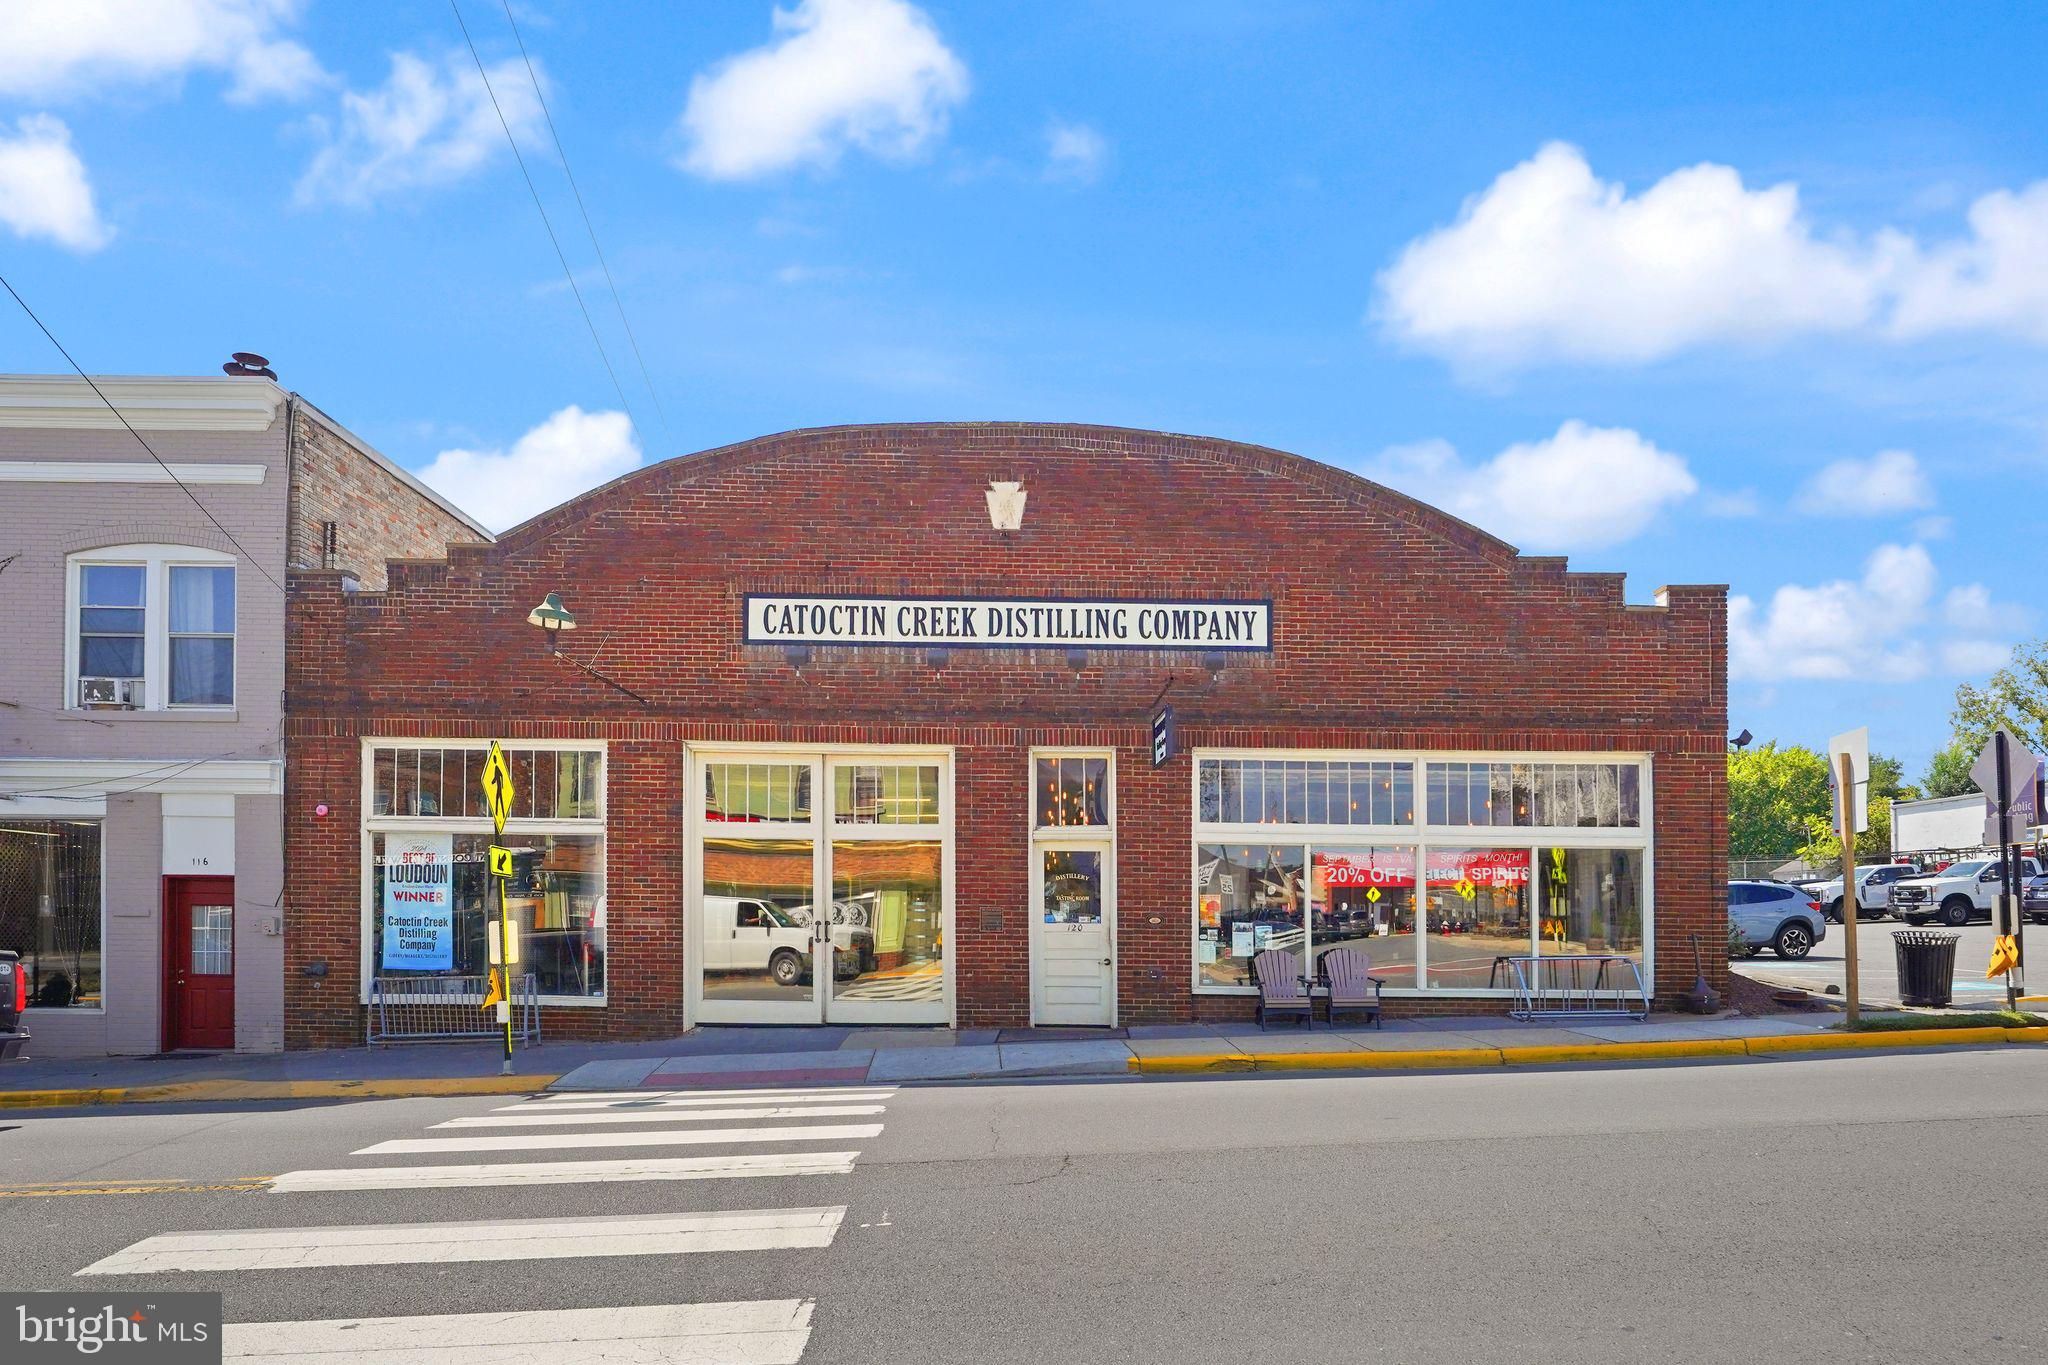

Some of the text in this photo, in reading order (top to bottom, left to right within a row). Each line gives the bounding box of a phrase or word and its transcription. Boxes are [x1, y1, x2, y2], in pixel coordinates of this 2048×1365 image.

[763, 604, 1257, 641] CATOCTIN CREEK DISTILLING COMPANY
[192, 857, 209, 866] 116
[402, 852, 424, 864] BEST
[1383, 855, 1393, 864] IS
[1441, 853, 1478, 863] SPIRITS
[1484, 853, 1523, 862] MONTH!
[389, 864, 448, 884] LOUDOUN
[1055, 873, 1090, 881] DISTILLERY
[1327, 867, 1529, 883] 20% OFF ELECT SPIRITS
[393, 891, 444, 903] WINNER
[388, 915, 449, 927] Catoctin Creek
[1067, 924, 1083, 932] 120
[399, 928, 438, 941] Distilling
[400, 939, 436, 952] Company
